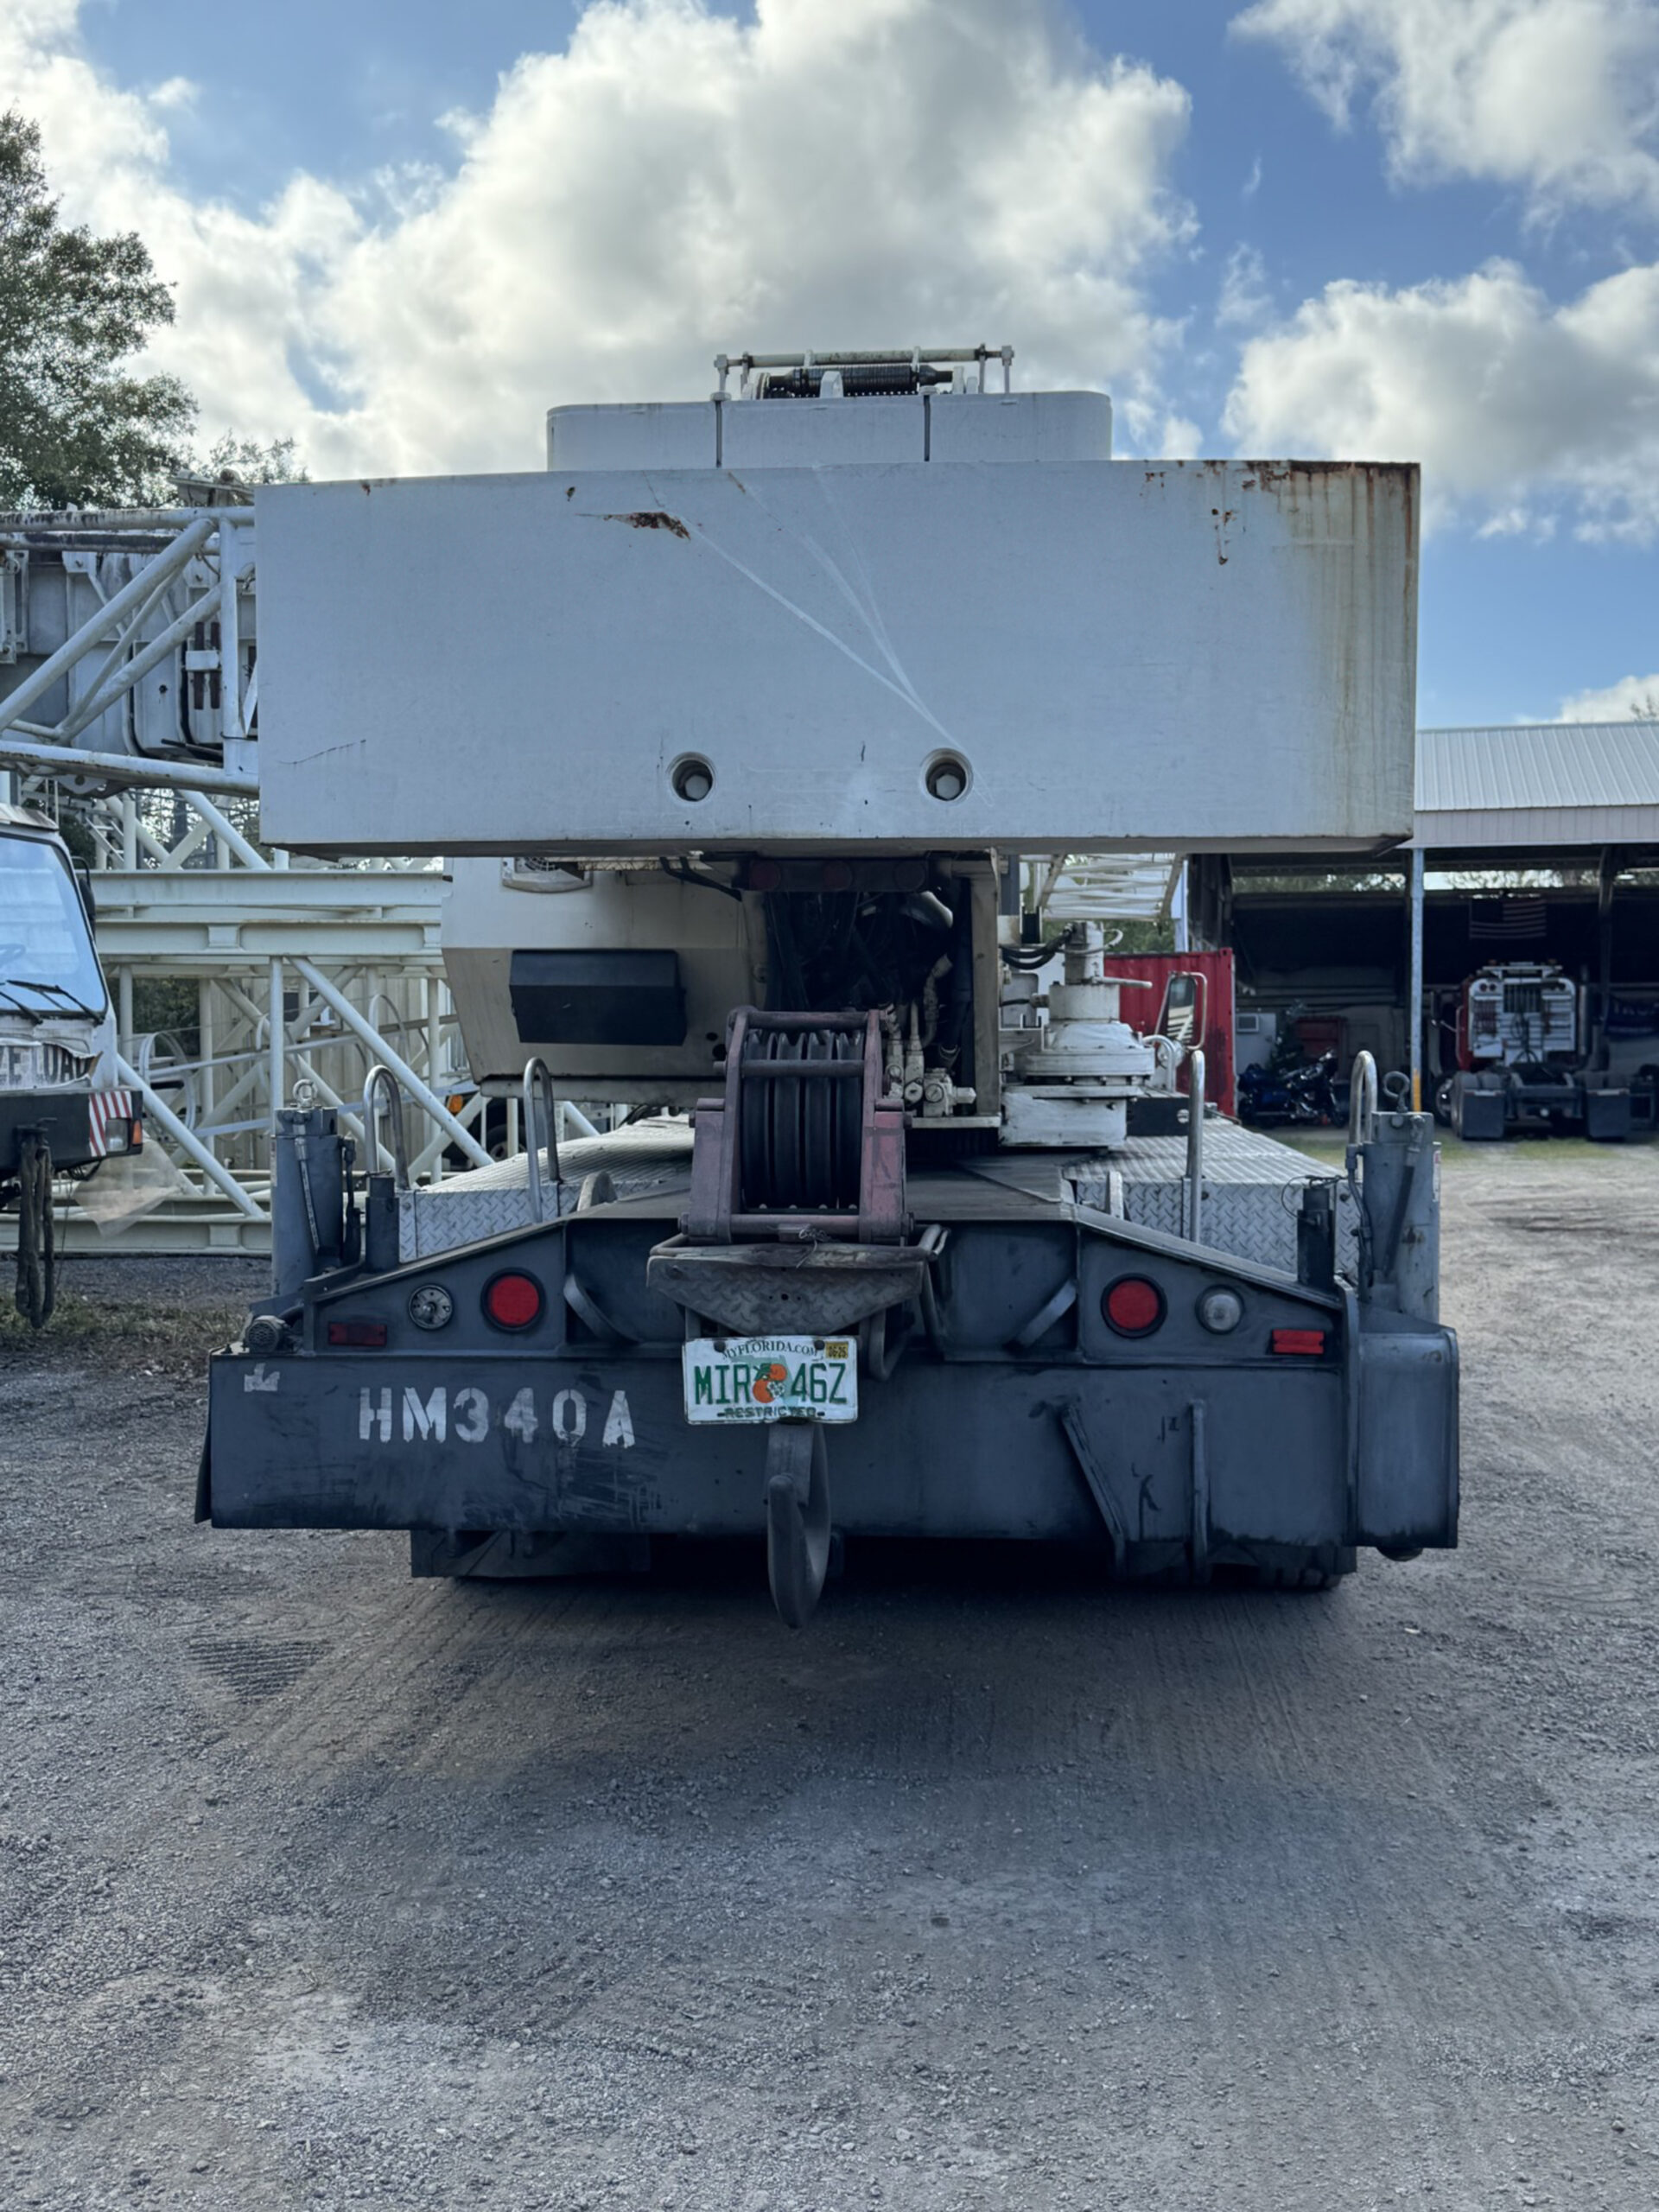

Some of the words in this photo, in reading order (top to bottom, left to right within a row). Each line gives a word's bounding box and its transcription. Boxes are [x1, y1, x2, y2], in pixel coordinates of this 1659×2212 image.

[694, 1363, 751, 1405] MIR
[791, 1363, 848, 1404] 46Z
[724, 1407, 817, 1419] RESTRICTED
